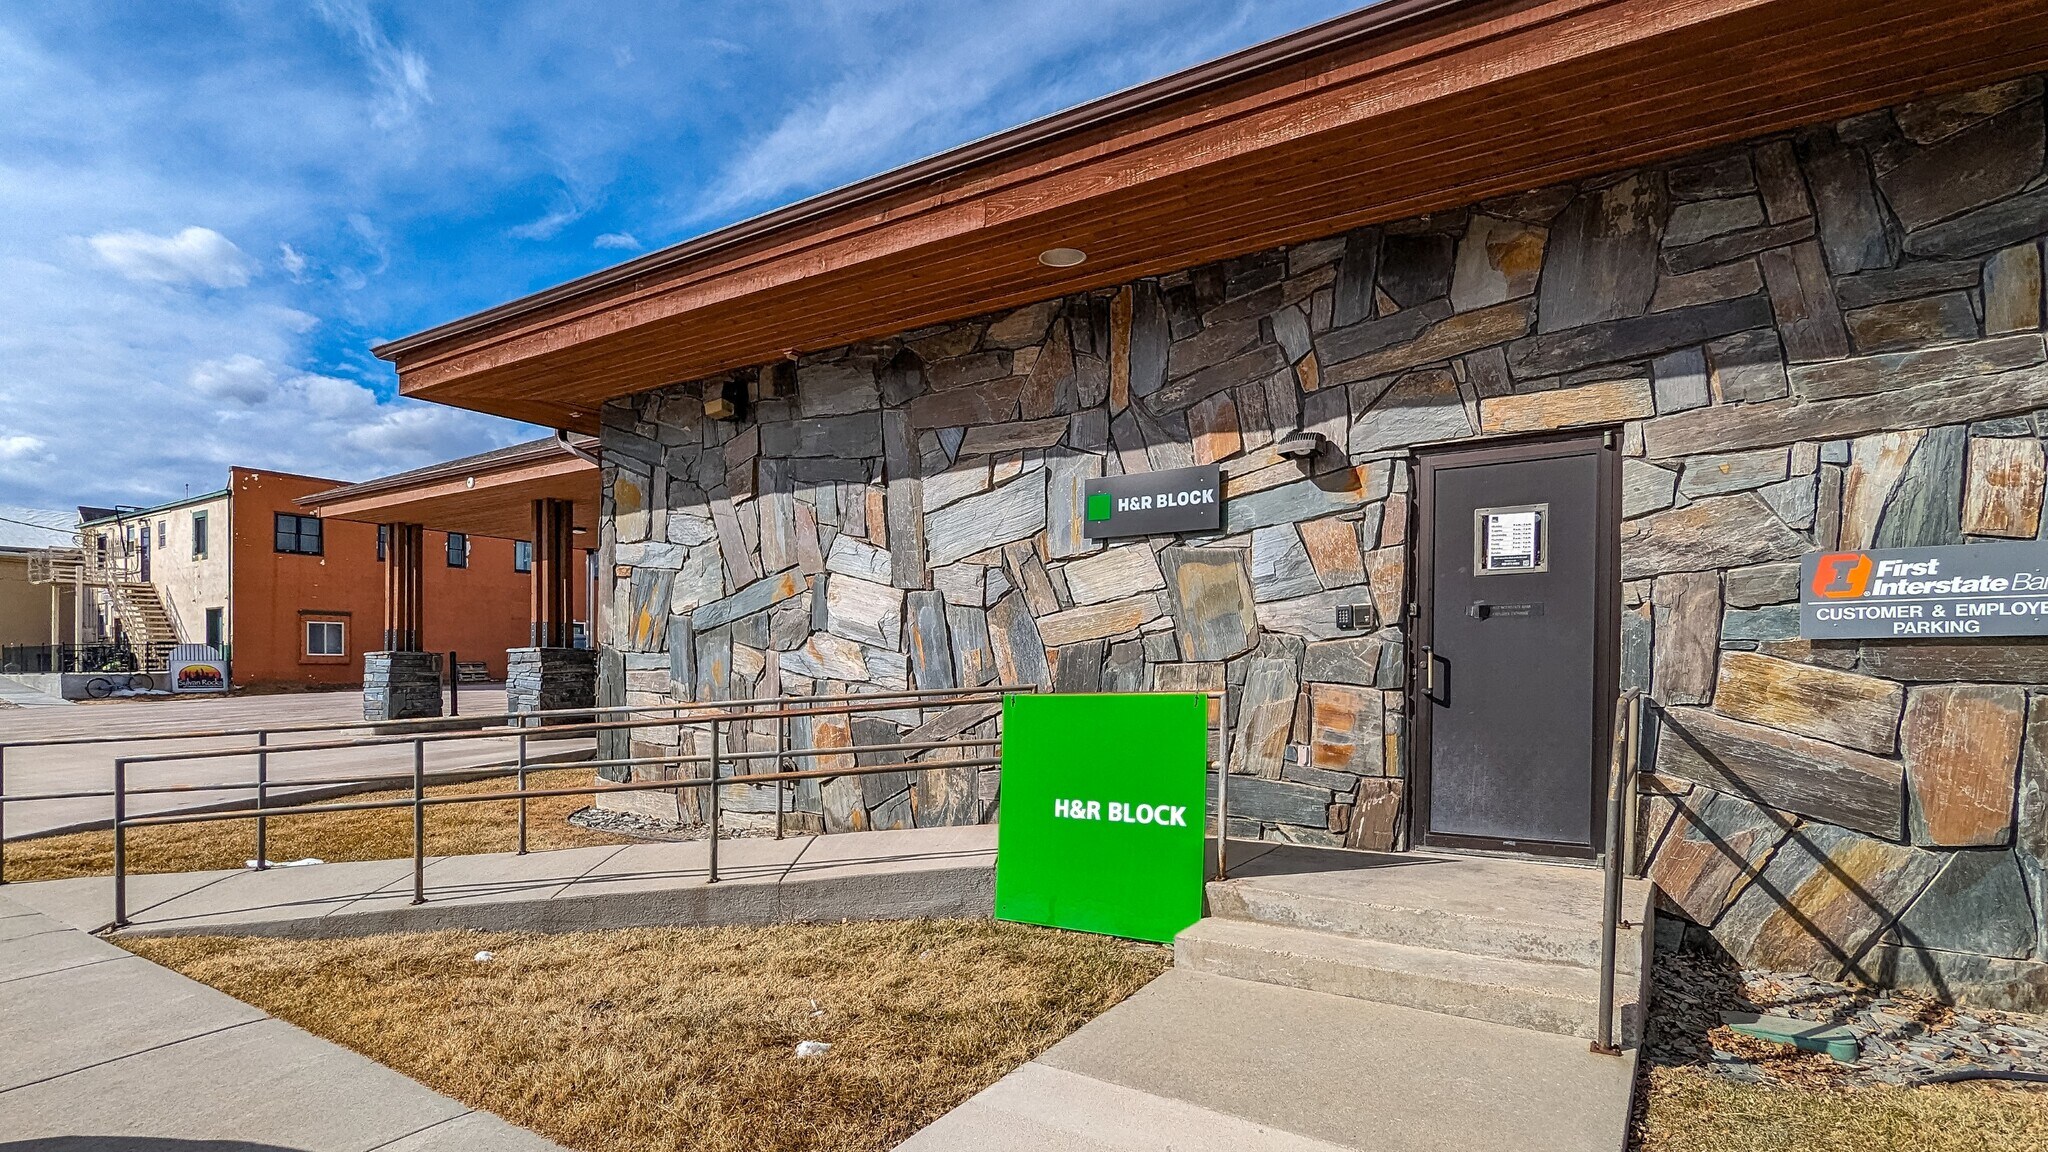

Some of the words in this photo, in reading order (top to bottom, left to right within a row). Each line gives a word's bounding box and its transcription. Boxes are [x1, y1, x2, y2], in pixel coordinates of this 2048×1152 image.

[1118, 496, 1152, 512] H&R
[1156, 488, 1214, 508] BLOCK
[1876, 558, 1940, 578] First
[1871, 576, 2009, 596] Interstate
[1816, 605, 1923, 621] CUSTOMER
[1932, 605, 1946, 618] &
[1893, 619, 1980, 635] PARKING
[1054, 798, 1101, 820] H&R
[1108, 802, 1187, 827] BLOCK
